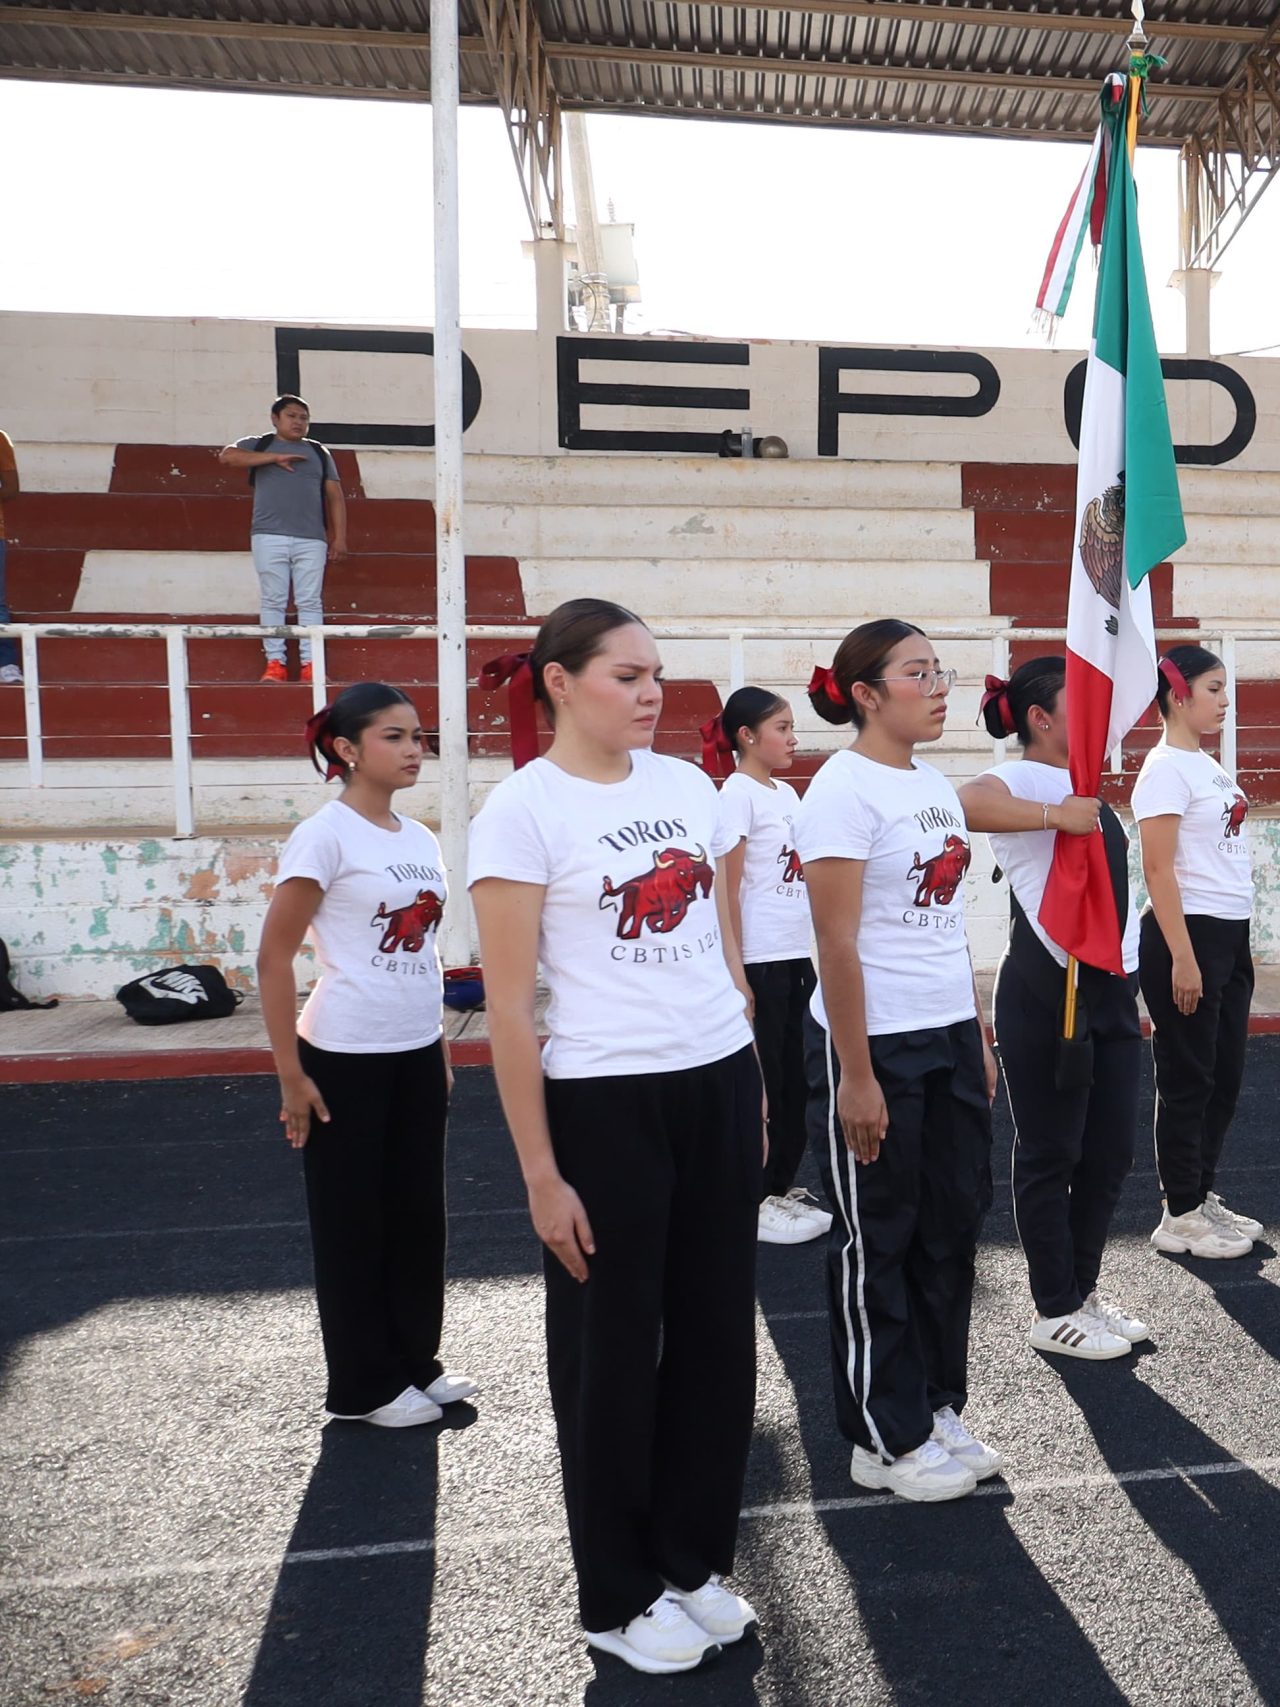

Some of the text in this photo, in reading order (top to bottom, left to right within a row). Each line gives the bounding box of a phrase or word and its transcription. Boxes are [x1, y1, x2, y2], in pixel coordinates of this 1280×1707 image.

[914, 806, 961, 834] TOROS
[598, 818, 687, 853] TOROS
[385, 863, 443, 883] TOROS
[902, 910, 957, 929] CBTIS
[610, 944, 693, 963] CBTIS
[371, 955, 428, 975] CBTIS
